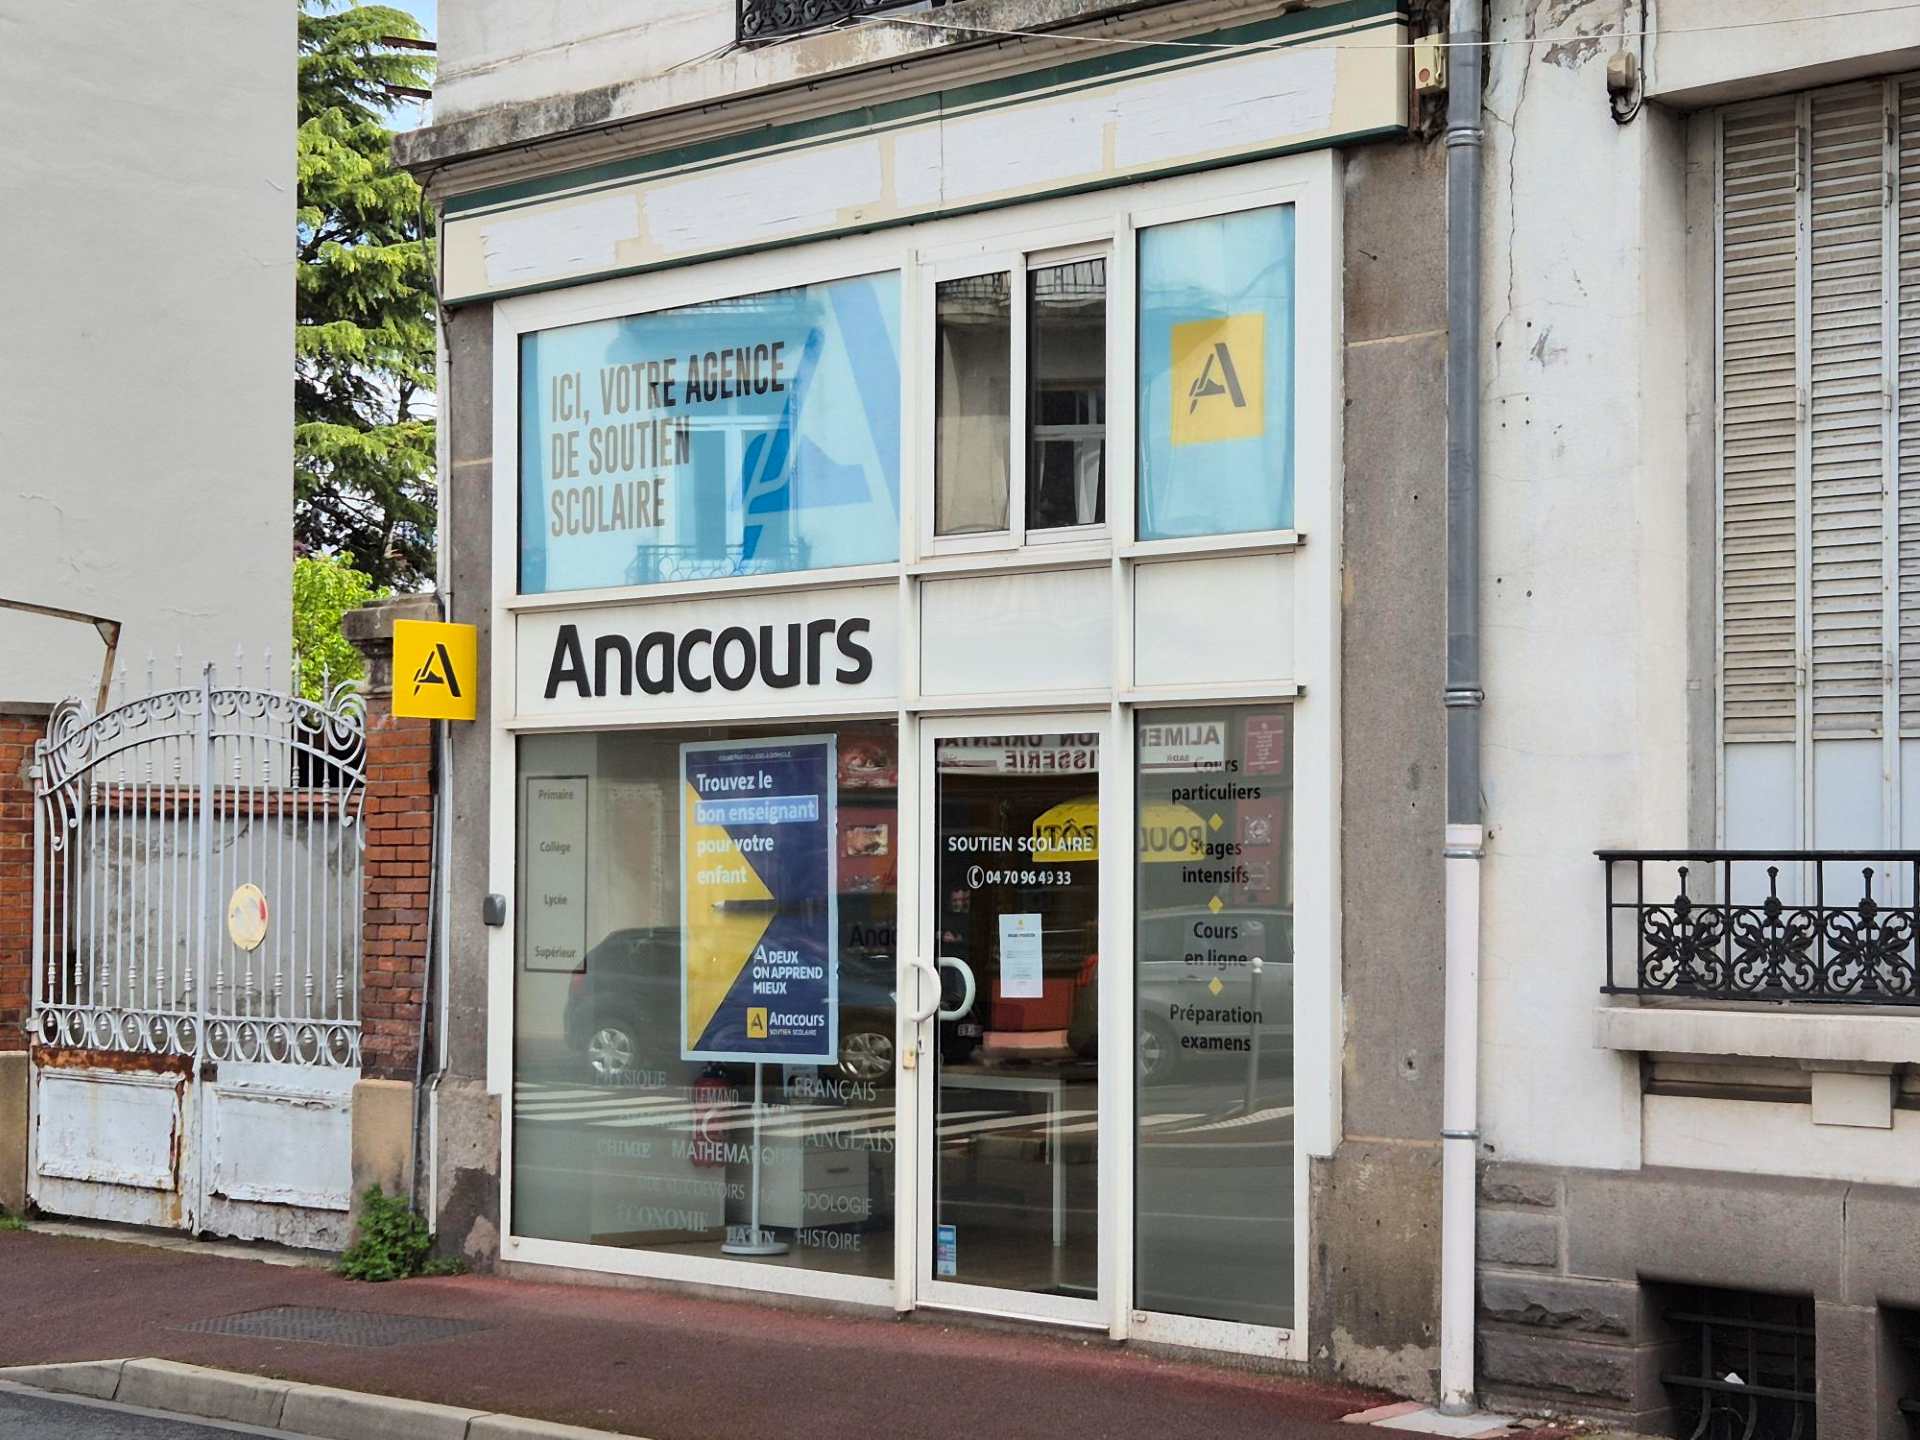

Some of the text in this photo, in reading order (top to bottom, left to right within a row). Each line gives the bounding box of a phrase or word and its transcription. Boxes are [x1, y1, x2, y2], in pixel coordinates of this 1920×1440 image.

[552, 341, 785, 425] ICI, VOTRE AGENCE
[551, 415, 690, 480] DE SOUTIEN
[551, 478, 666, 537] SCOLAIRE
[544, 617, 873, 698] Anacours
[412, 643, 463, 698] A
[697, 770, 773, 792] Trouvez le
[538, 789, 574, 800] Primaire
[1171, 782, 1262, 805] particuliers
[697, 801, 816, 824] bon enseignant
[540, 841, 571, 855] Collège
[697, 834, 774, 857] pour votre
[948, 836, 1092, 852] SOUTIEN SCOLAIRE
[1189, 839, 1243, 860] Stages
[698, 866, 748, 885] enfant
[986, 870, 1071, 885] 04 70 96 49 33
[1182, 866, 1250, 884] intensifs
[544, 894, 568, 907] Lycée
[1193, 921, 1239, 939] Cours
[534, 944, 576, 959] Supérieur
[769, 951, 799, 964] DEUX
[1184, 949, 1248, 971] en ligne
[753, 966, 823, 979] ON APPREND
[753, 981, 787, 994] MIEUX
[769, 1011, 825, 1027] Anacours
[1170, 1003, 1263, 1024] Préparation
[1181, 1034, 1252, 1052] examens
[795, 1077, 877, 1104] FRANÇAIS
[805, 1127, 894, 1153] ANGLAIS
[797, 1229, 861, 1251] HISTOIRE
